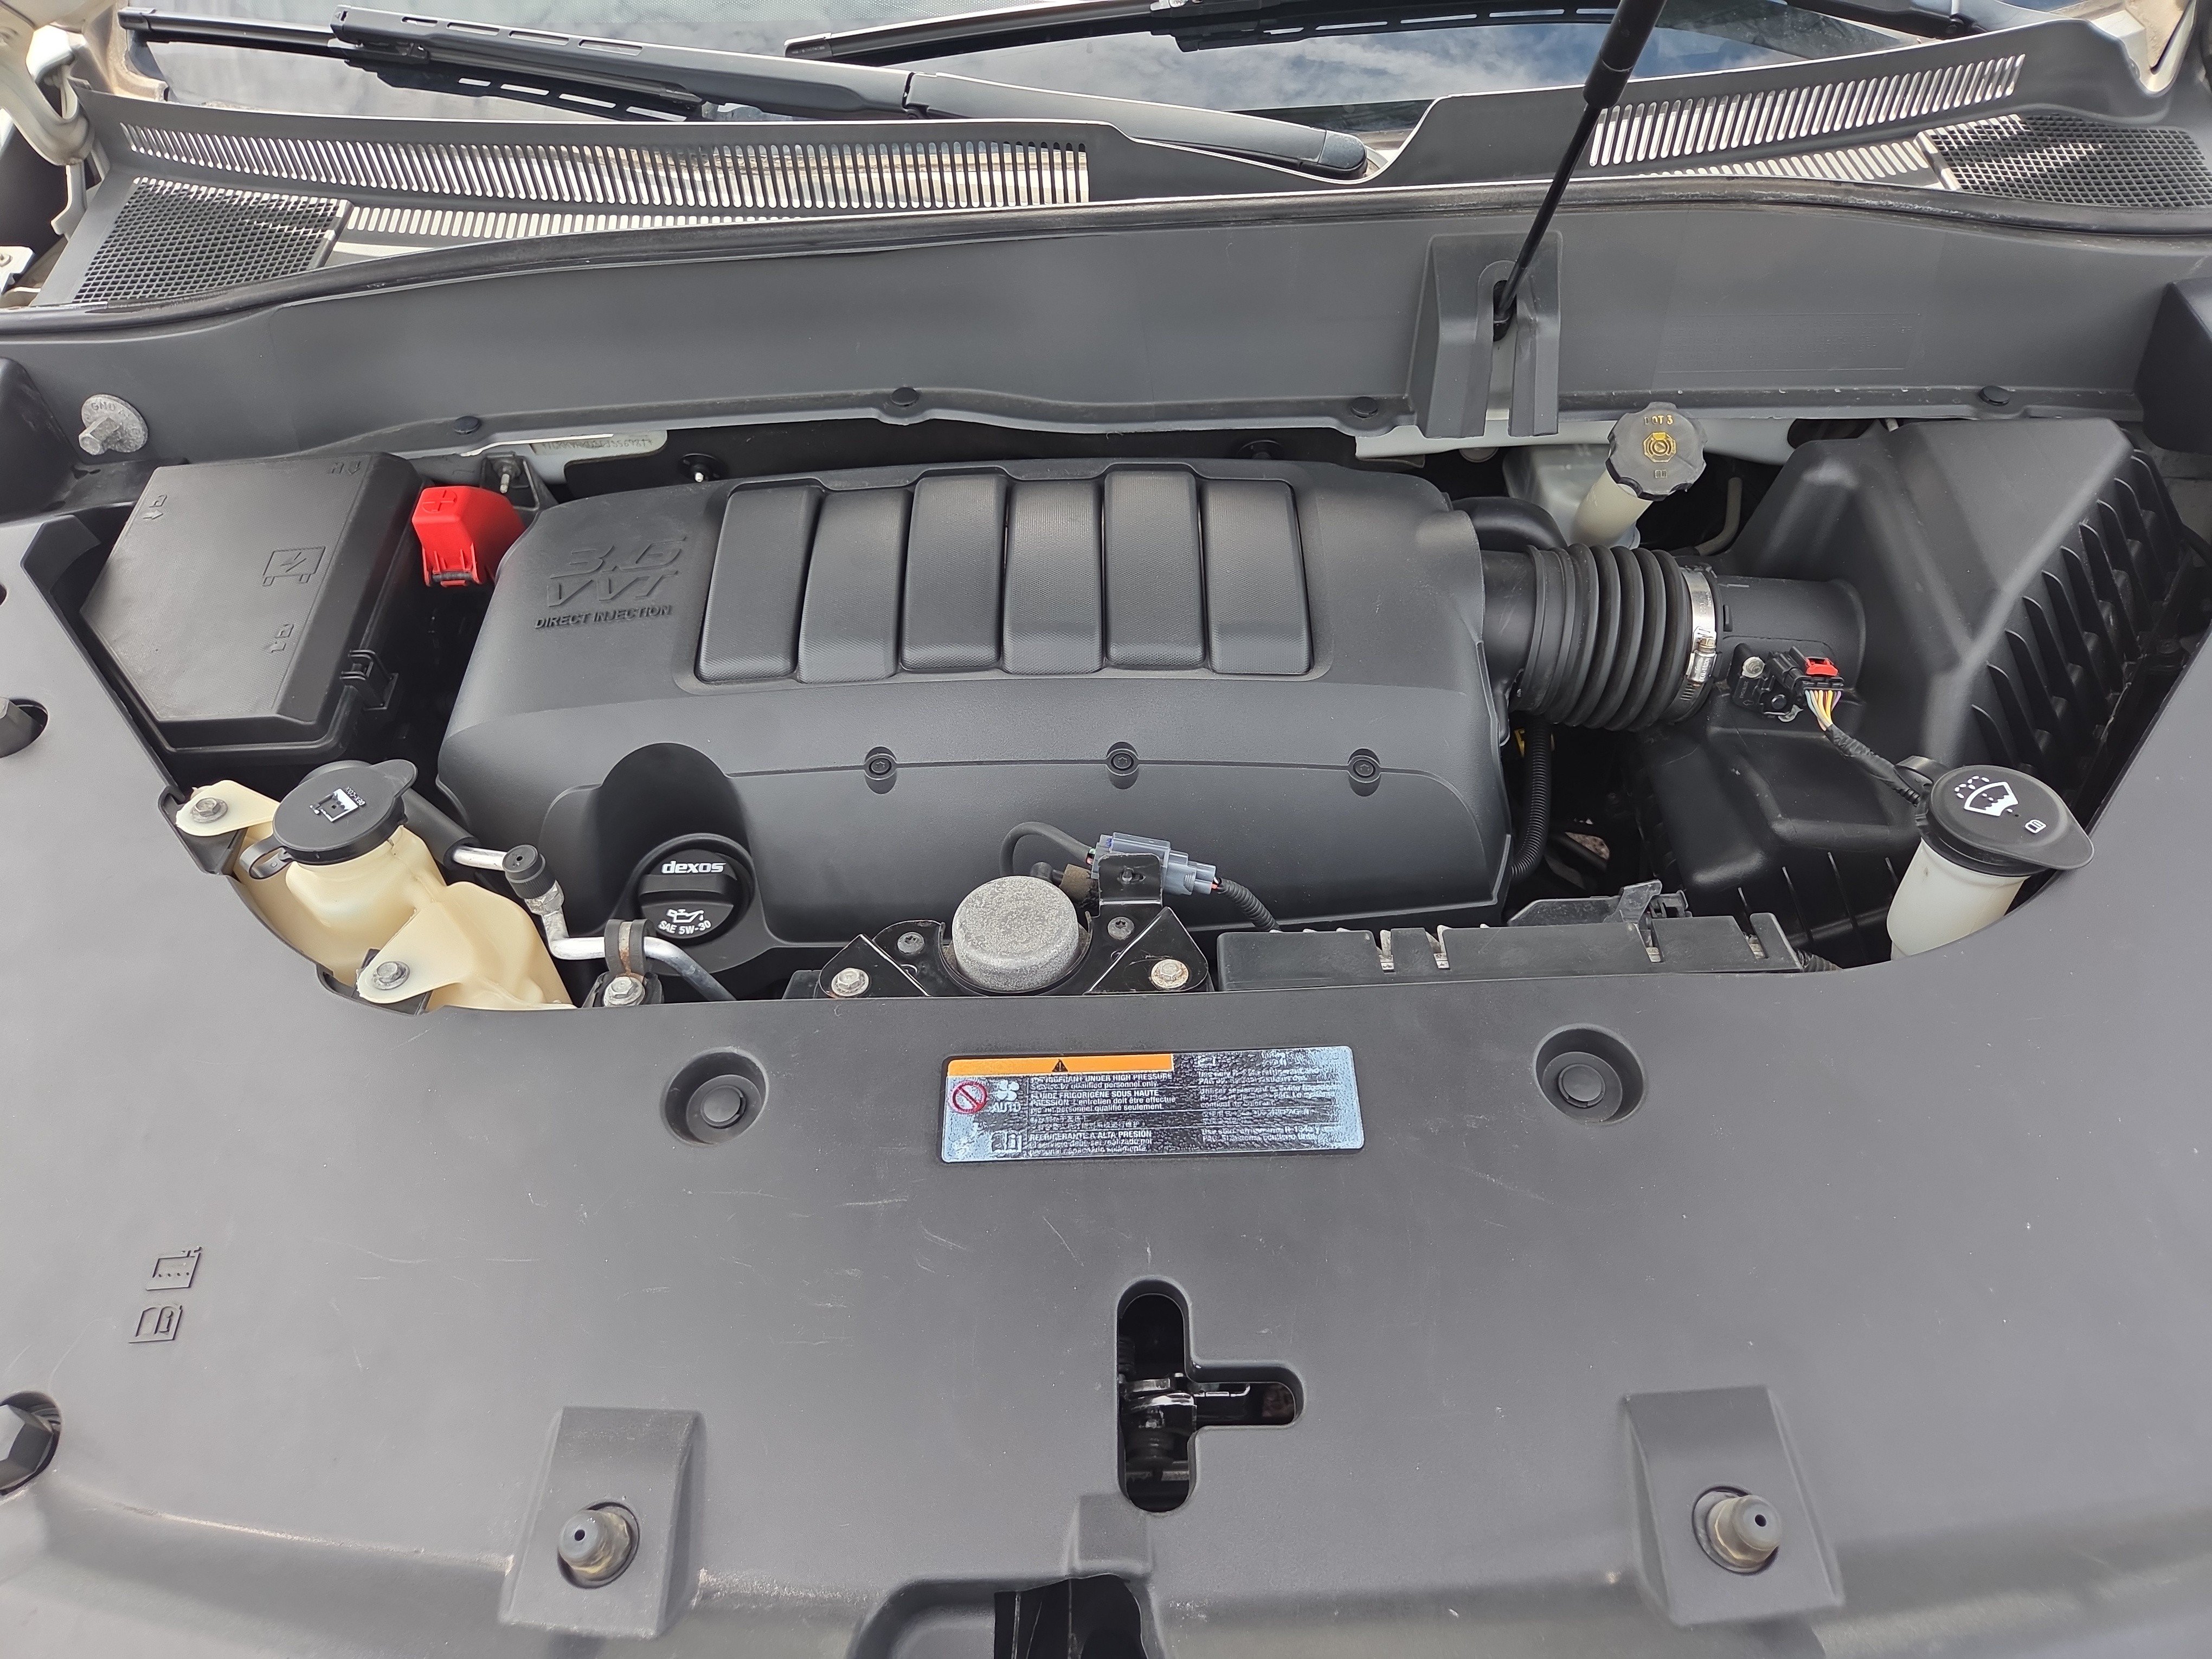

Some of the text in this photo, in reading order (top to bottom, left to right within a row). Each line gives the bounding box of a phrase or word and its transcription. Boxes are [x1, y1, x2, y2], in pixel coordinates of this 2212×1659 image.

[1667, 414, 1674, 426] 3
[550, 536, 687, 579] 3.6
[546, 570, 679, 608] VVT
[535, 604, 672, 628] DIRECT INJECTION
[661, 860, 726, 874] dexos
[658, 920, 712, 935] SAE 5W-30
